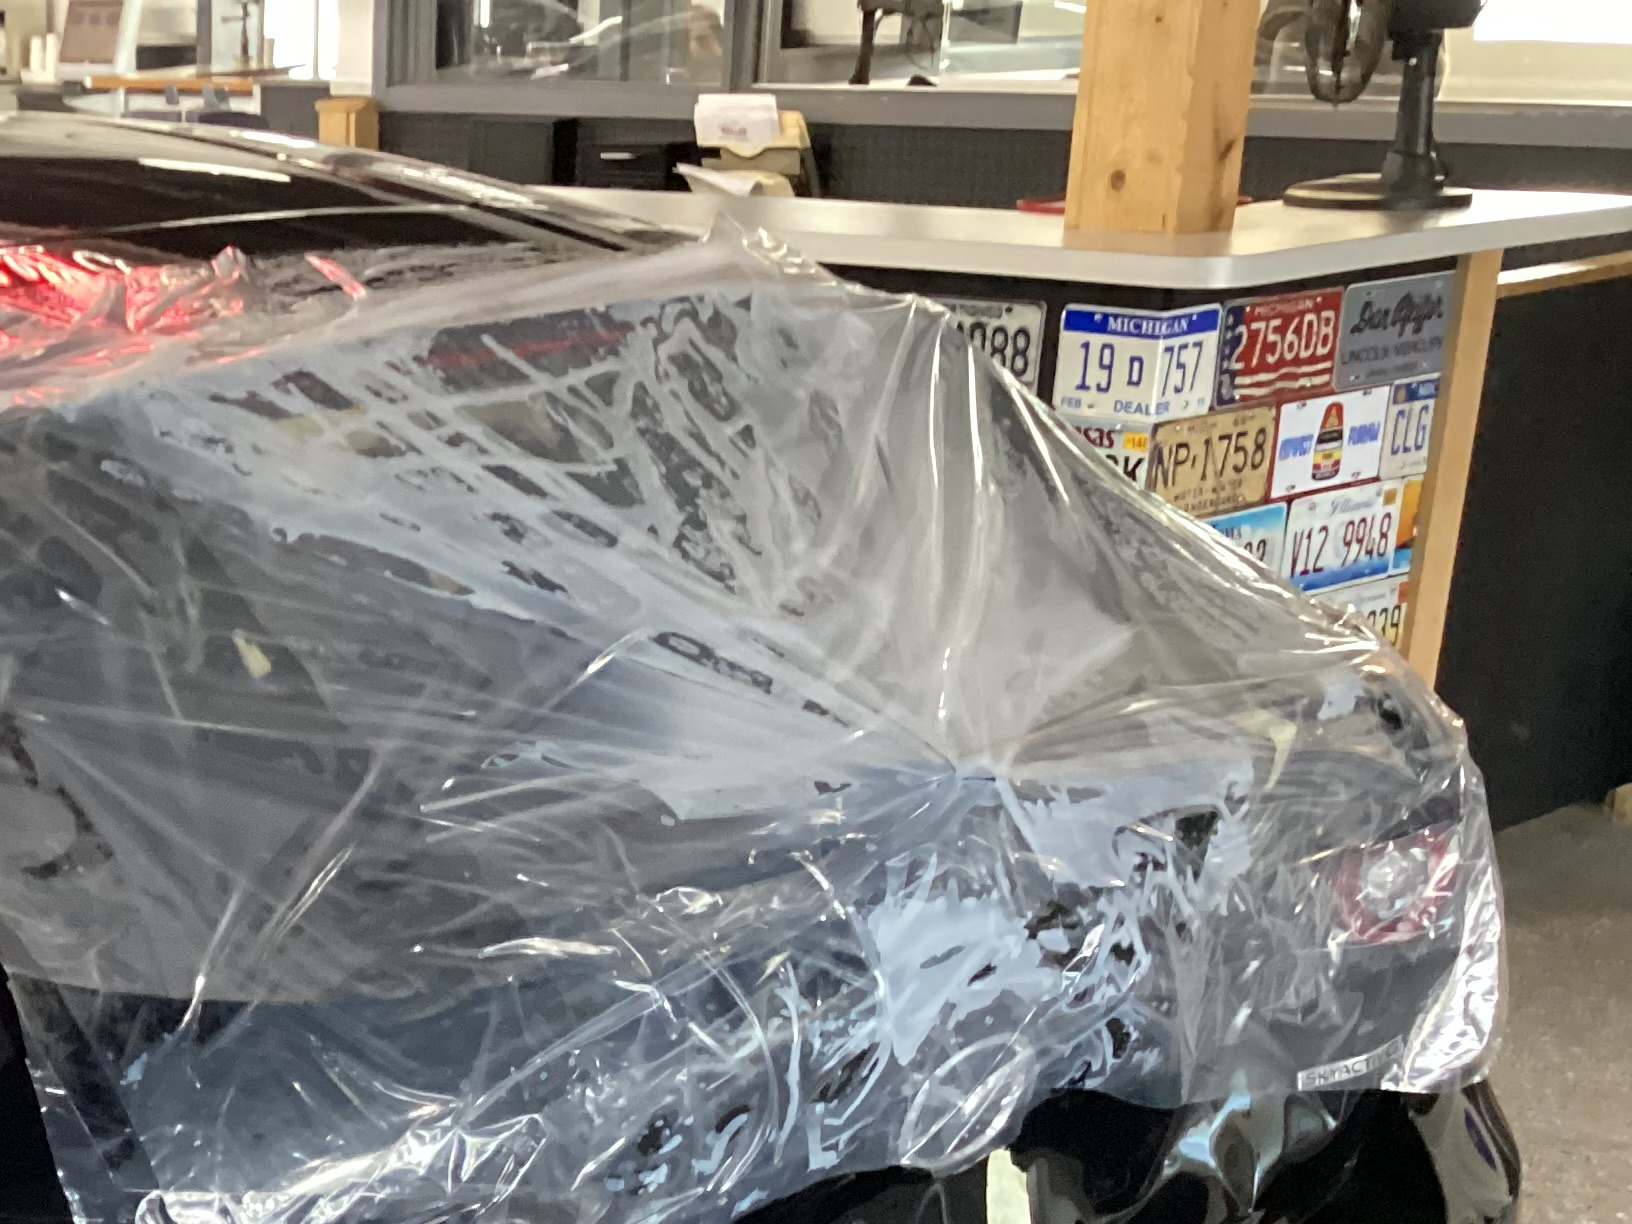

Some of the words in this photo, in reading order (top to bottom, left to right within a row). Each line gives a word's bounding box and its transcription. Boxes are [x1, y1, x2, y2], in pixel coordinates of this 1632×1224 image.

[1107, 314, 1189, 336] MICHIGAN
[1228, 310, 1336, 370] 2756DB
[1075, 340, 1115, 393] 19
[1126, 355, 1144, 388] D
[1161, 340, 1204, 398] 757
[1113, 398, 1170, 415] DEALER
[1291, 525, 1328, 578] V12
[1341, 512, 1392, 568] 9948
